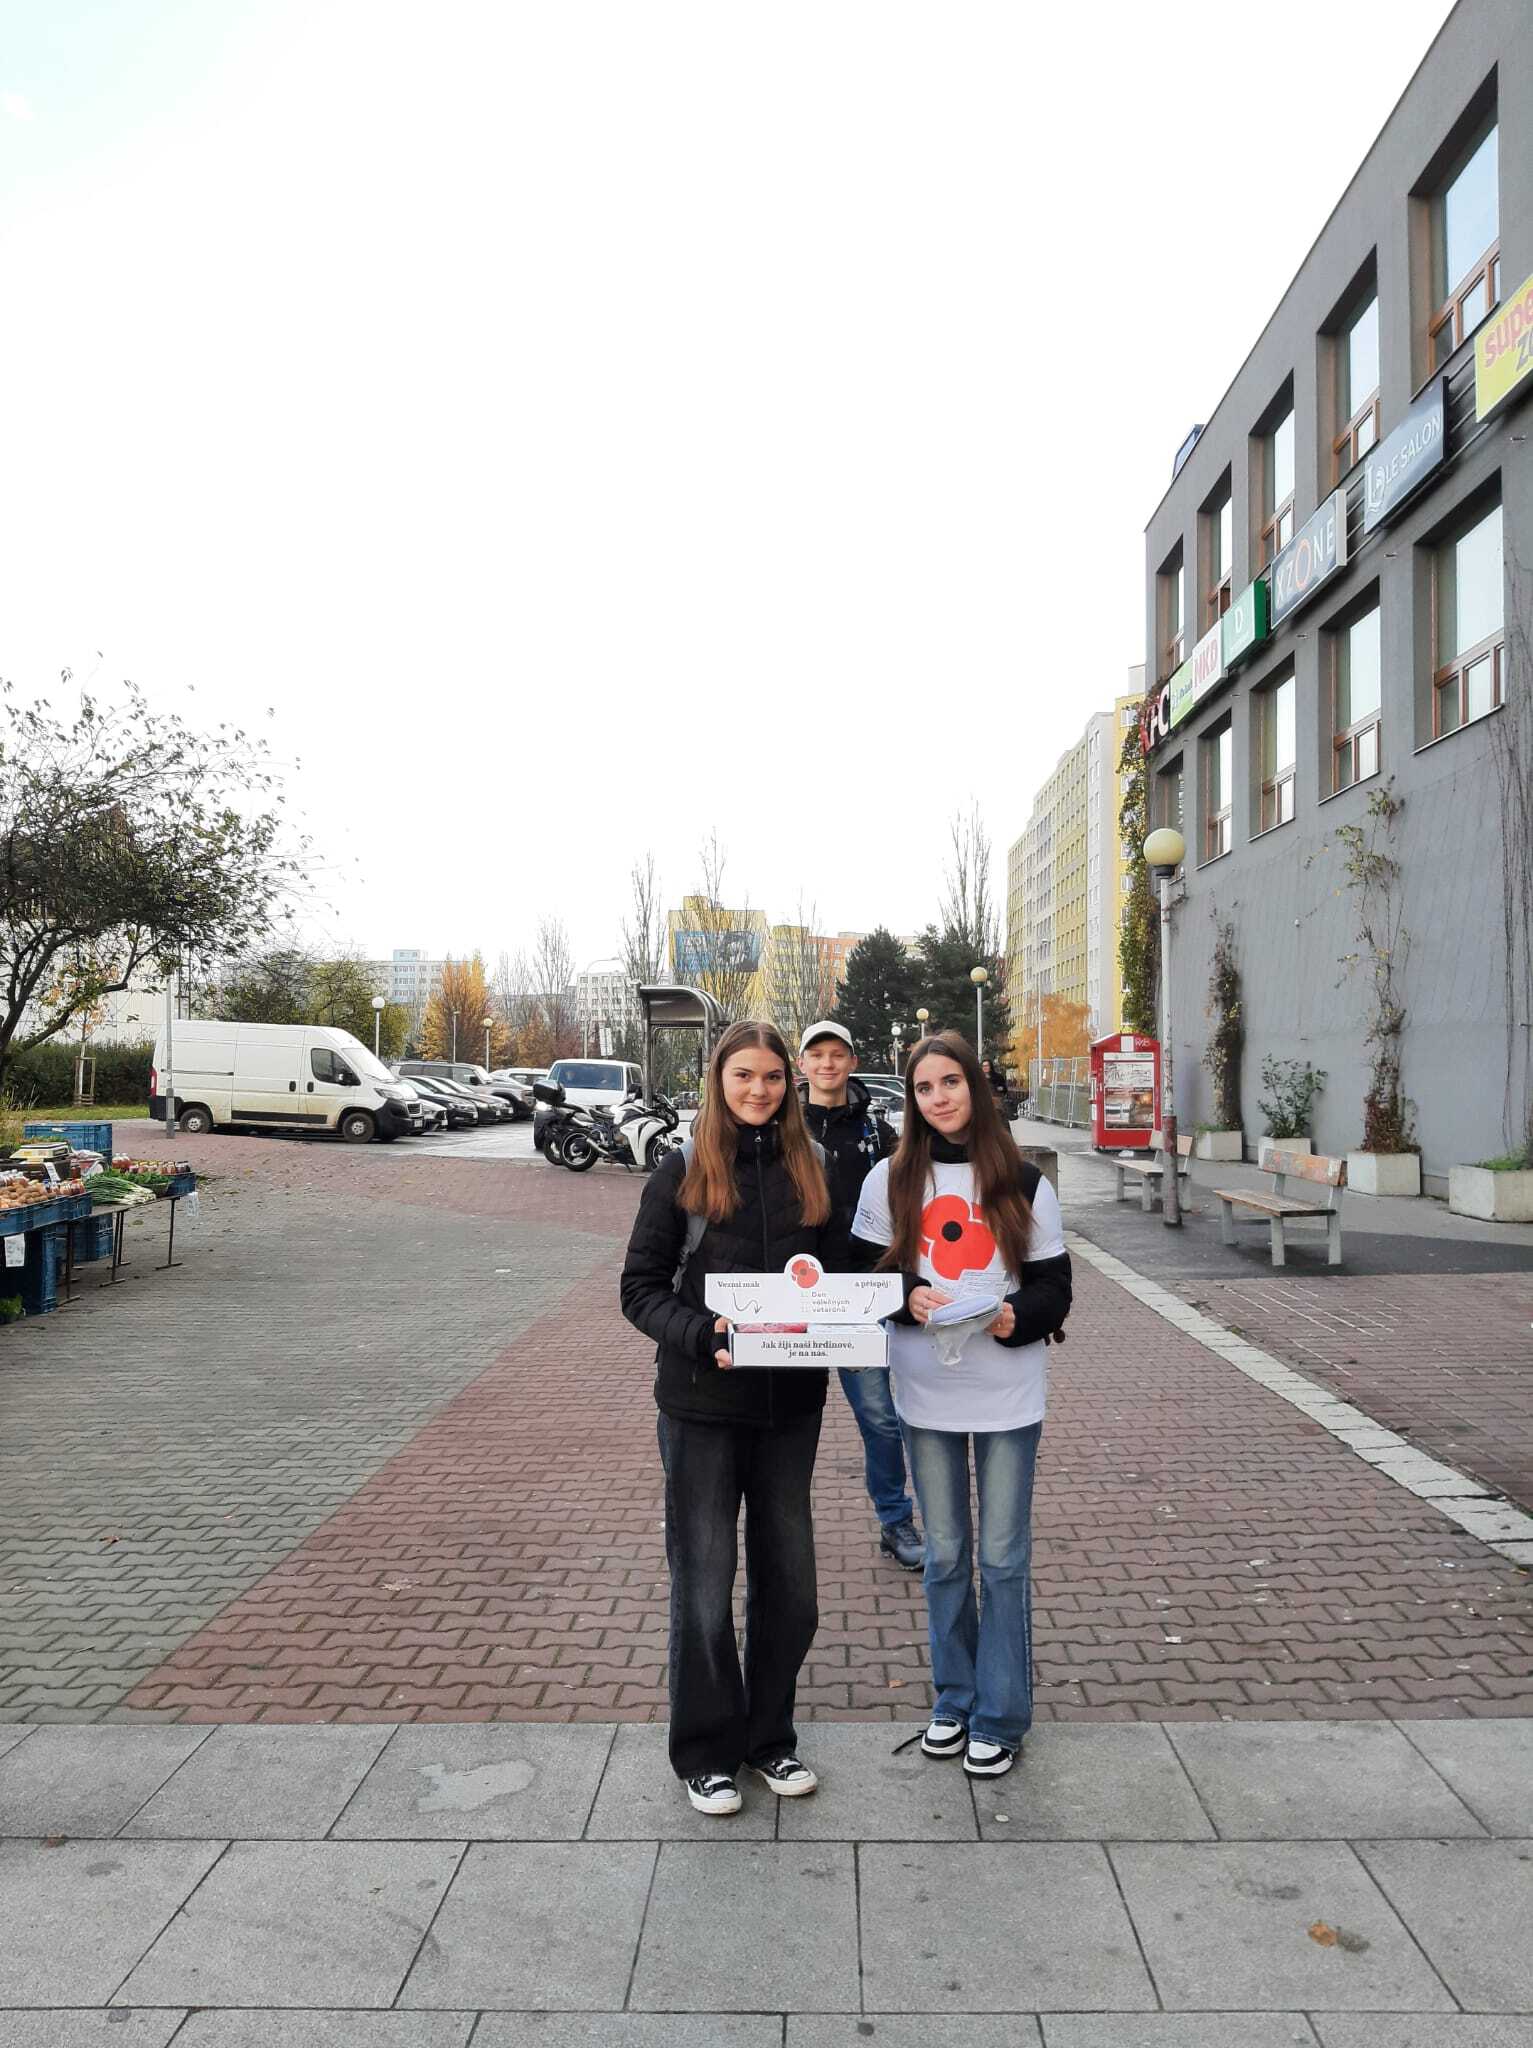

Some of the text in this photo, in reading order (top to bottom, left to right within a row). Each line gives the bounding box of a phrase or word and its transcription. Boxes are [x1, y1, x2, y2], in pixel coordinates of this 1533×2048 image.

[1399, 414, 1442, 469] SALON
[1276, 518, 1335, 609] XZONE
[742, 1280, 760, 1289] mak
[761, 1340, 776, 1349] Jak
[793, 1340, 811, 1349] naši
[788, 1349, 797, 1358] je
